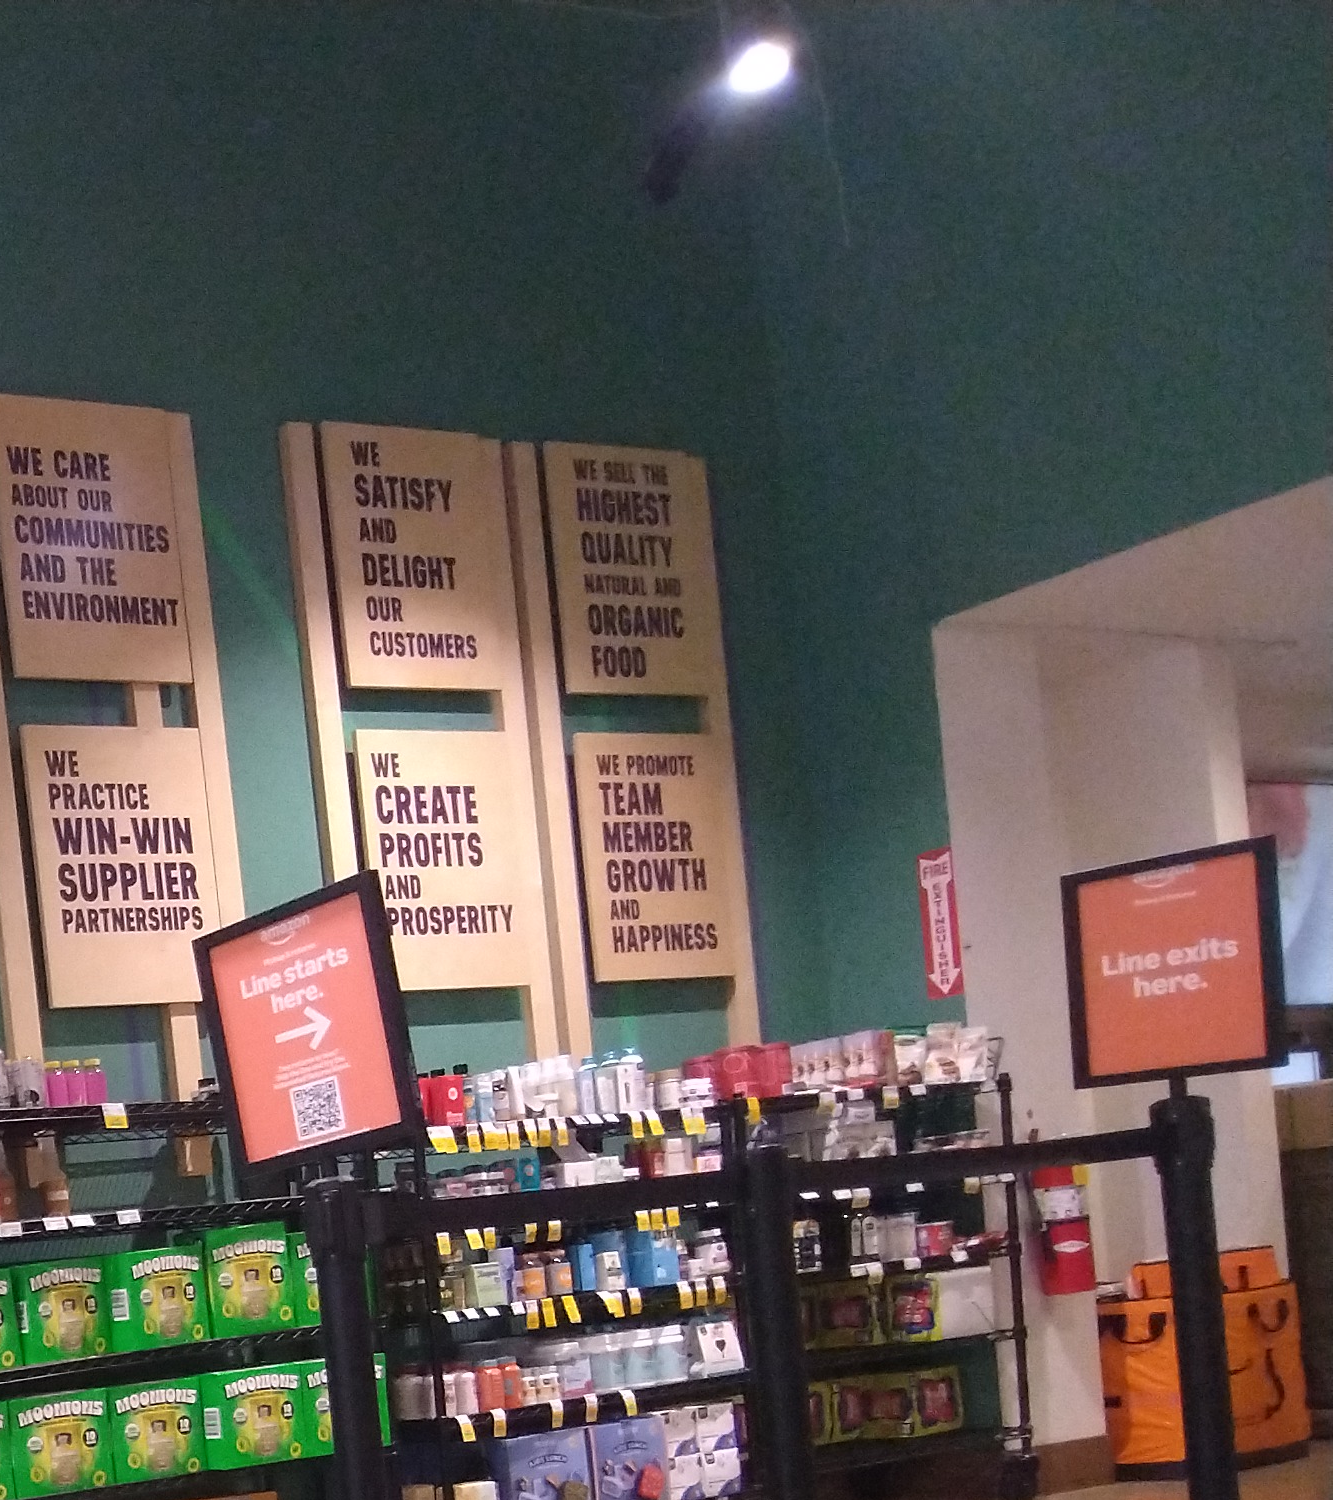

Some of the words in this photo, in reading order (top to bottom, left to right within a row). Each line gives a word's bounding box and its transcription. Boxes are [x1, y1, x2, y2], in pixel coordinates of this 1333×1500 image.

[6, 445, 43, 477] WE
[53, 450, 111, 482] CARE
[350, 441, 380, 467] WE
[573, 459, 597, 481] WE
[603, 461, 636, 485] SELL
[641, 463, 669, 487] THE
[11, 483, 68, 509] ABOUT
[78, 488, 113, 513] OUR
[354, 473, 452, 513] SATISFY
[576, 488, 671, 526] HIGHEST
[14, 514, 170, 553] COMMUNITIES
[359, 517, 396, 544] AND
[580, 531, 672, 567] QUALITY
[20, 552, 66, 584] AND
[76, 555, 118, 587] THE
[361, 552, 456, 590] DELIGHT
[583, 573, 648, 597] NATURAL
[655, 577, 681, 598] AND
[22, 590, 179, 627] ENVIRONMENT
[366, 596, 403, 622] OUR
[587, 603, 685, 639] ORGANIC
[369, 630, 478, 660] CUSTOMERS
[591, 645, 647, 679] FOOD
[44, 750, 80, 778] WE
[370, 752, 401, 778] WE
[596, 754, 620, 776] WE
[626, 754, 695, 777] PROMOTE
[47, 782, 150, 811] PRACTICE
[375, 784, 479, 826] CREATE
[598, 781, 663, 817] TEAM
[52, 816, 195, 856] WIN-WIN
[379, 831, 484, 869] PROFITS
[601, 820, 694, 854] MEMBER
[56, 861, 200, 902] SUPPLIER
[605, 857, 708, 893] GROWTH
[923, 862, 949, 881] FIRE
[384, 874, 422, 900] AND
[61, 906, 204, 934] PARTNERSHIPS
[387, 903, 514, 937] PROSPERITY
[609, 898, 640, 921] AND
[612, 922, 719, 954] HAPPINESS
[1101, 950, 1161, 978] Line
[1166, 937, 1239, 967] exits
[239, 972, 283, 1001] Line
[283, 946, 349, 985] starts
[1133, 972, 1209, 998] here.
[270, 984, 324, 1014] here.
[212, 1239, 287, 1264] MOONIONS
[29, 1267, 102, 1293] MOONIONS
[131, 1254, 201, 1281] MOONIONS
[114, 1388, 198, 1414] MOONIONS
[224, 1373, 299, 1399] MOONIONS
[17, 1400, 104, 1428] MOONIONS
